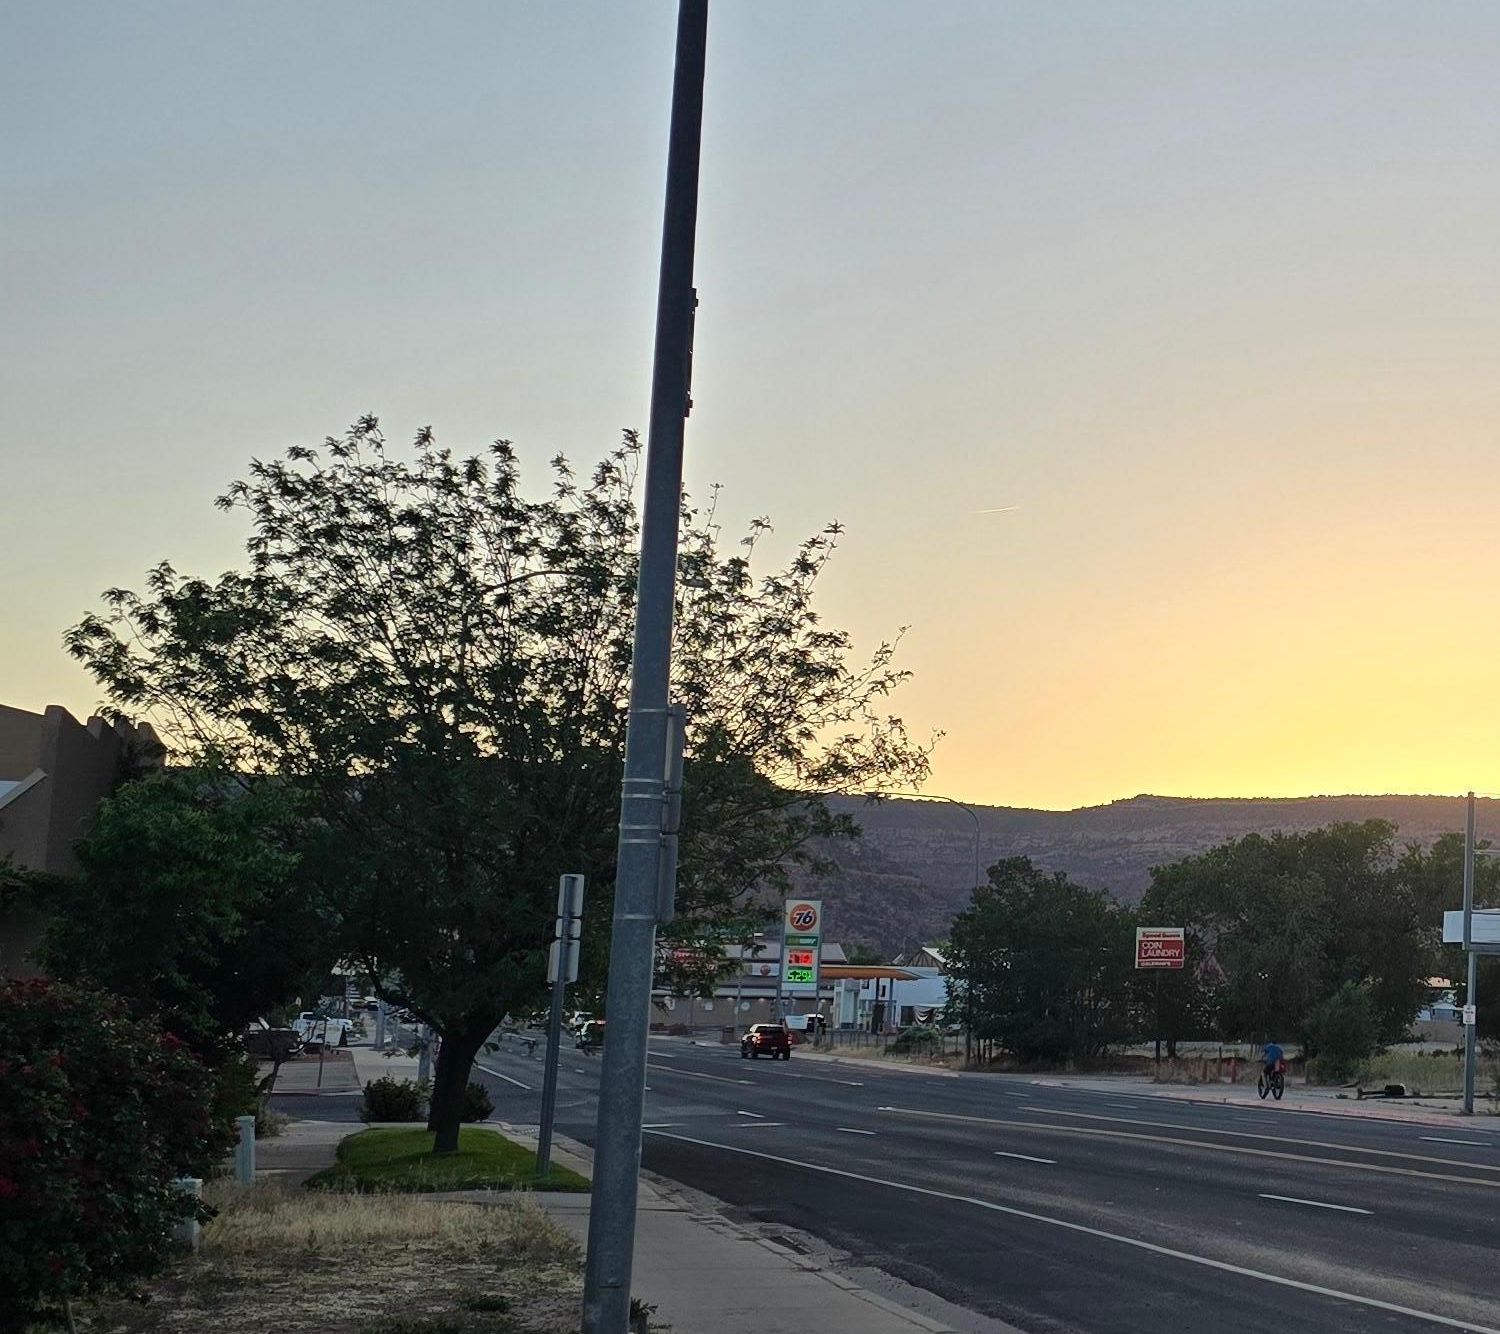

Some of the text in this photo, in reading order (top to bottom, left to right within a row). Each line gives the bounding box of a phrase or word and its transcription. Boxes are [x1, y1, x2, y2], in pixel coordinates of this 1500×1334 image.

[792, 910, 815, 926] 76
[1142, 941, 1163, 950] COIN
[1141, 949, 1181, 957] LAUNDRY
